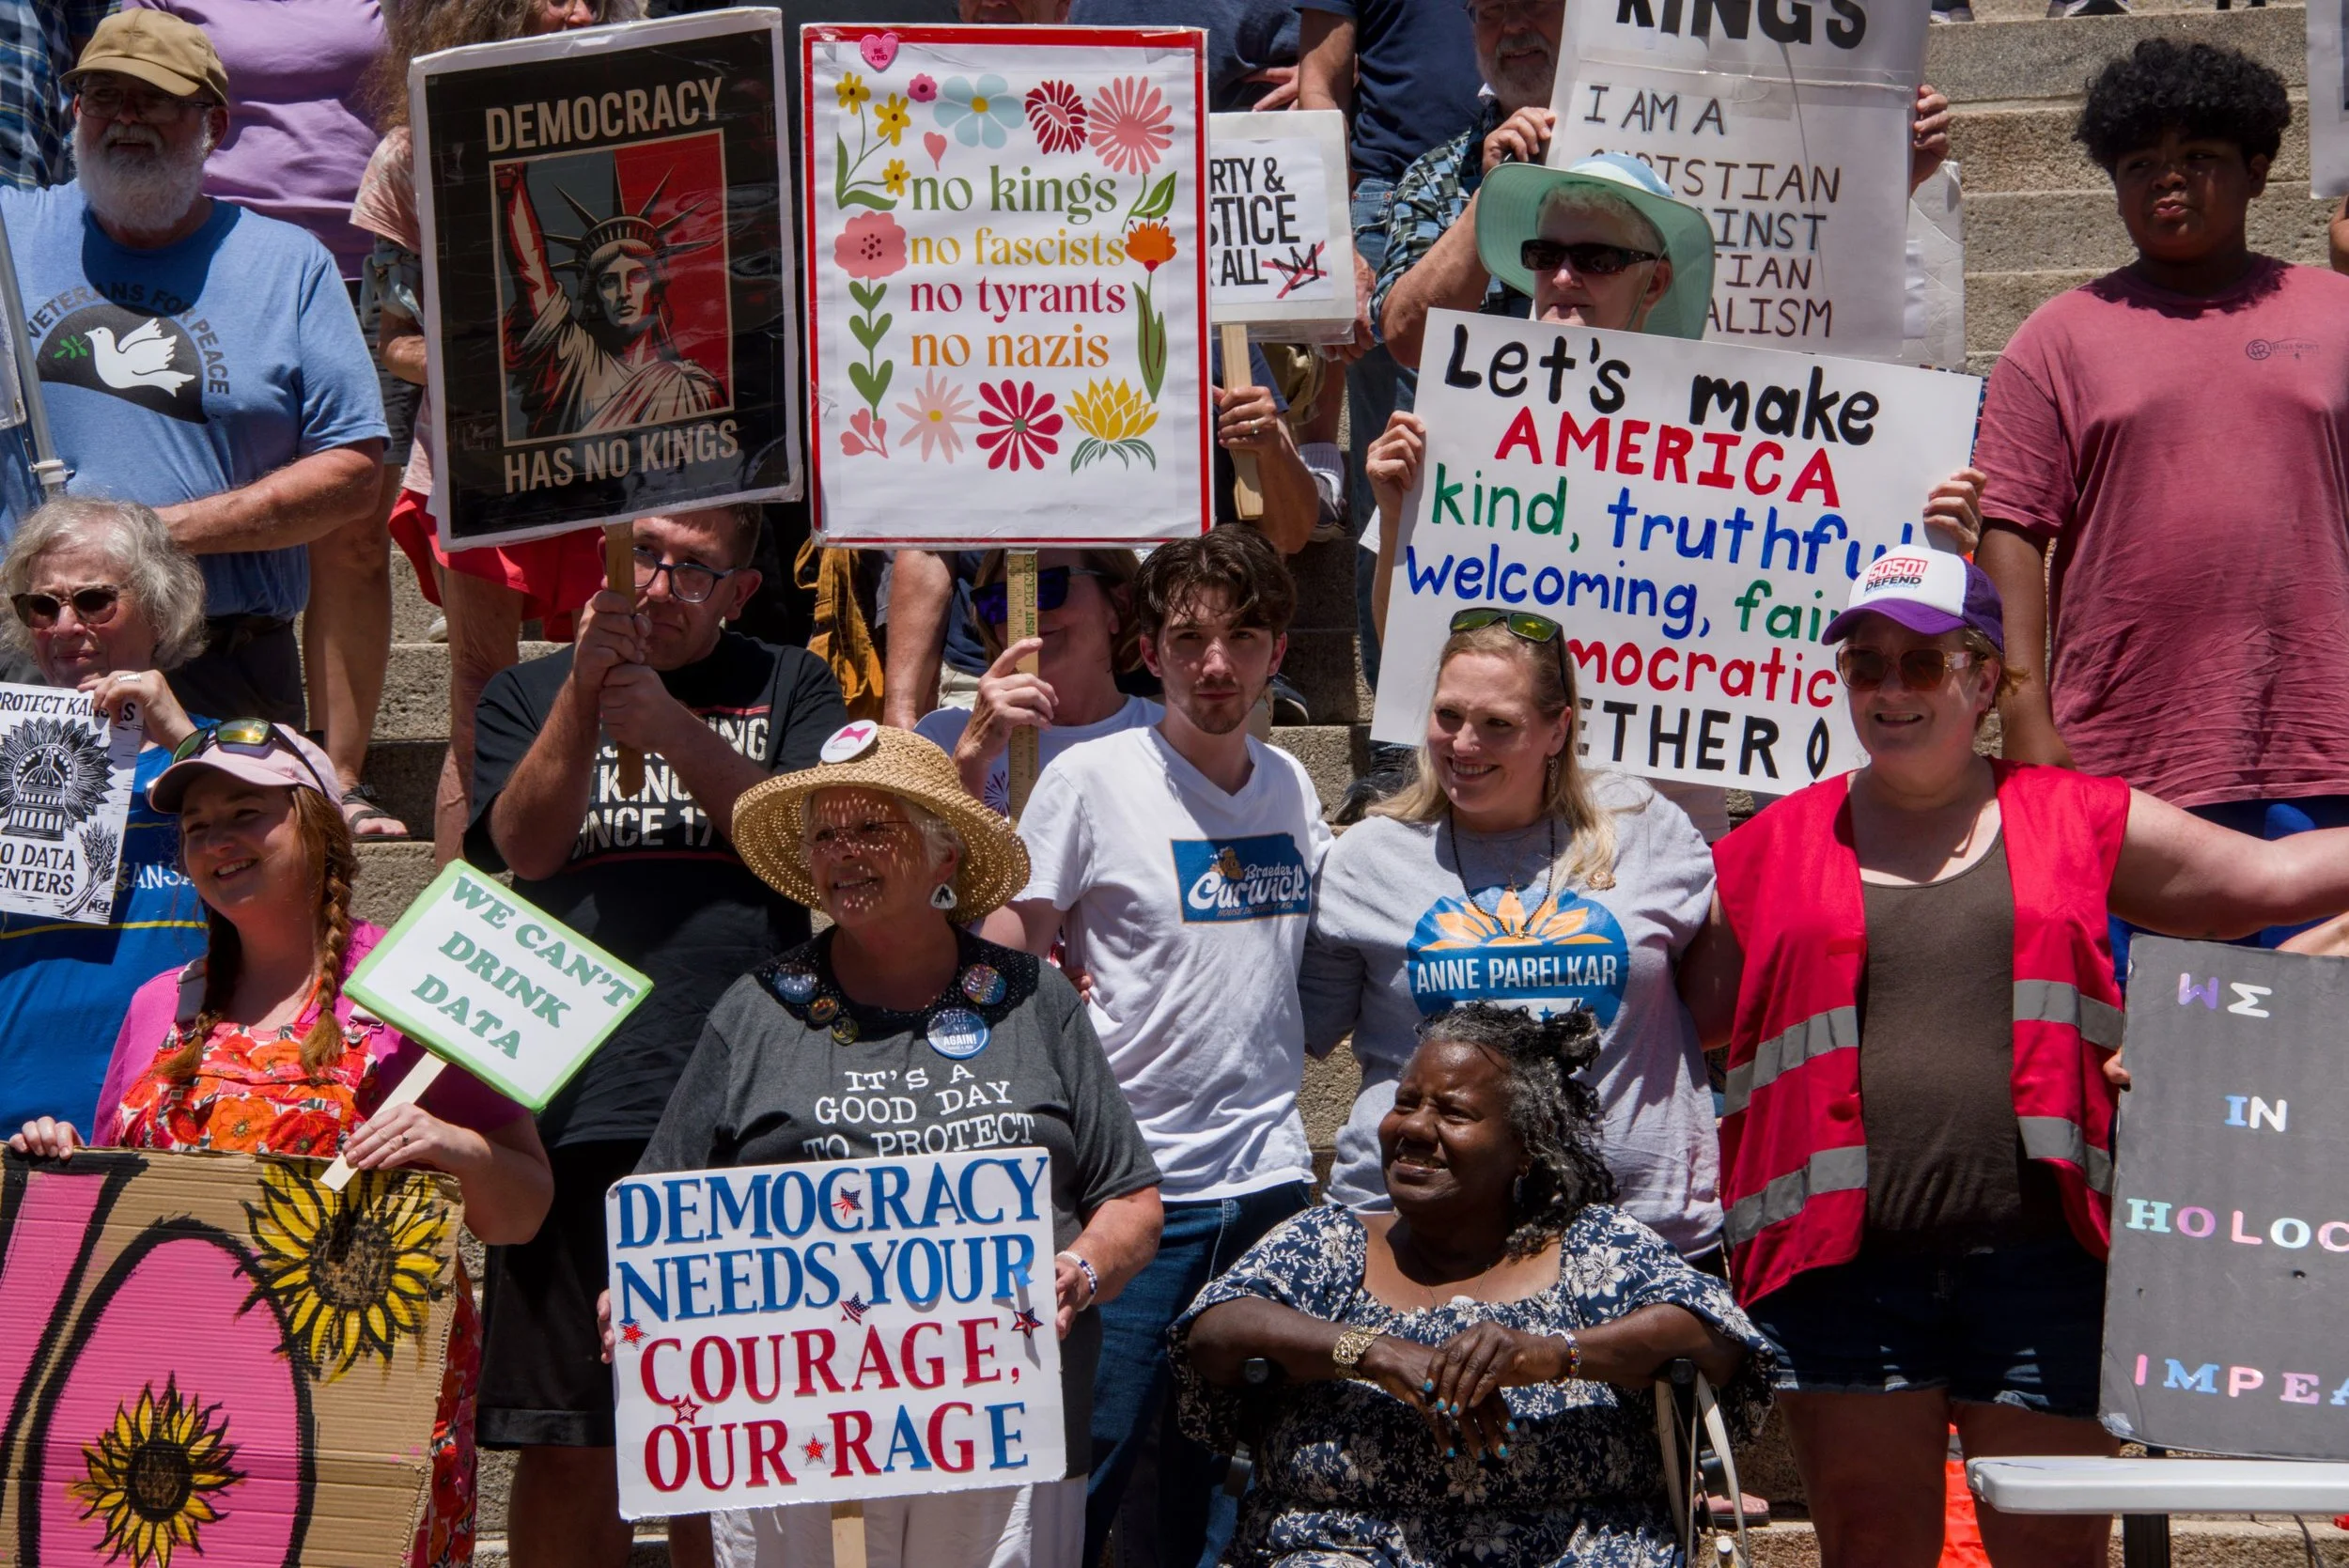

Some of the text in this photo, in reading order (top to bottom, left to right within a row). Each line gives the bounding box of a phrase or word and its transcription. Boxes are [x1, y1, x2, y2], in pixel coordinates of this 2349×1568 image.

[485, 76, 723, 152] DEMOCRACY
[1583, 85, 1726, 136] I AM A
[910, 164, 1118, 225] no kings
[1263, 156, 1286, 194] &
[1592, 148, 1841, 204] ISTIAN
[910, 226, 1127, 268] no fascists
[1703, 208, 1828, 251] INST
[1221, 248, 1268, 287] ALL
[910, 276, 1127, 323] no tyrants
[27, 282, 230, 396] VETERANS FOR PEACE
[910, 323, 1110, 368] no nazis
[1444, 323, 1880, 446] Let's make
[504, 418, 739, 494] HAS NO KINGS
[1494, 406, 1842, 508] AMERICA
[1431, 462, 1582, 553] kind,
[1406, 544, 1711, 640] welcoming,
[1865, 576, 1922, 592] DEFEND
[1868, 559, 1929, 582] 50501
[1024, 611, 1035, 637] VISIT
[0, 691, 65, 715] ROTECT
[21, 845, 76, 872] DATA
[1243, 861, 1294, 882] Braeden
[450, 876, 636, 1007] WE CAN'T
[438, 930, 572, 1029] DRINK
[1416, 955, 1617, 995] ANNE PARELKAR
[411, 973, 521, 1060] DATA
[943, 1033, 977, 1046] AGAIN!
[815, 1080, 1014, 1126] GOOD DAY
[844, 1063, 975, 1093] IT'S A
[802, 1112, 1035, 1162] TO PROTECT
[2223, 1094, 2289, 1133] IN
[614, 1157, 1049, 1250] DEMOCRACY
[615, 1233, 1035, 1325] NEEDS YOUR
[639, 1316, 1021, 1406] COURAGE,
[644, 1401, 1030, 1494] OUR RAGE
